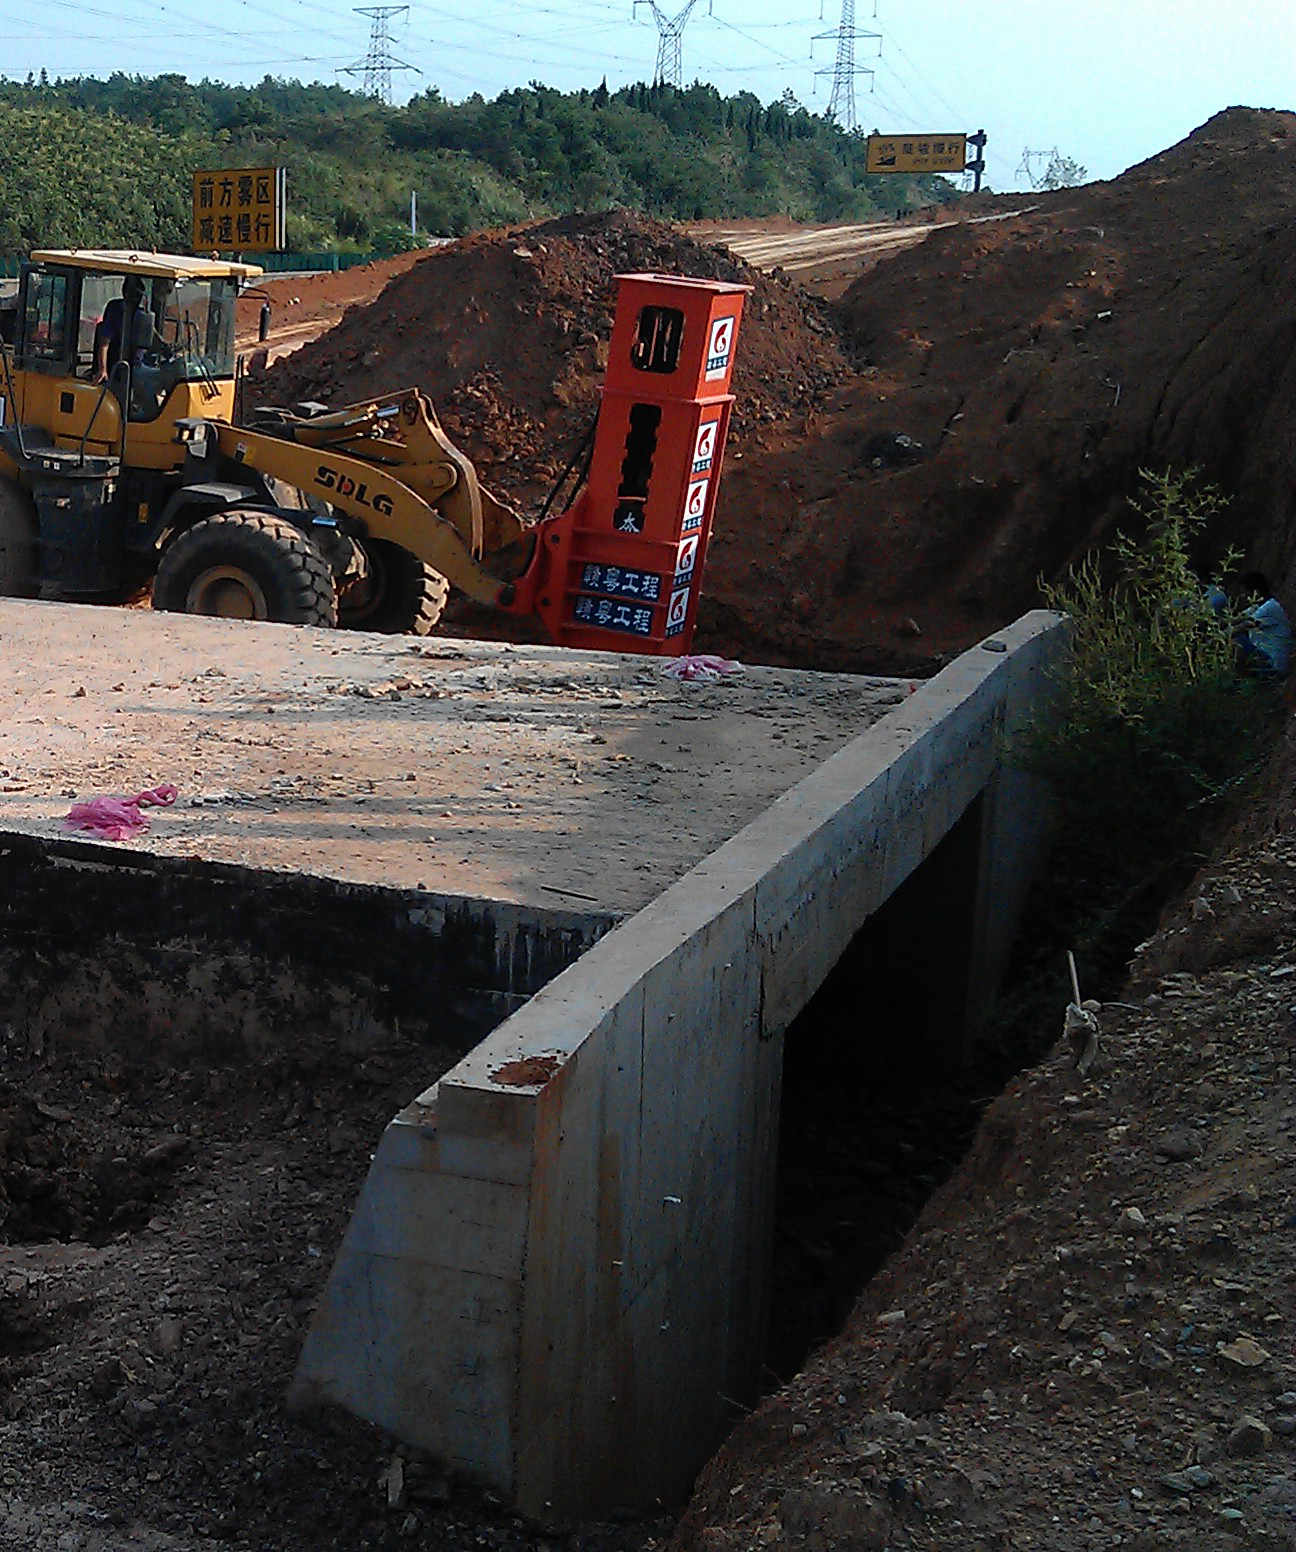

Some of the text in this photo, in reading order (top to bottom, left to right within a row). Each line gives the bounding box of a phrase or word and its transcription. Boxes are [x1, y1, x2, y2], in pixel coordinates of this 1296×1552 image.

[199, 176, 270, 208] 前方雾区
[313, 466, 394, 516] SDLG
